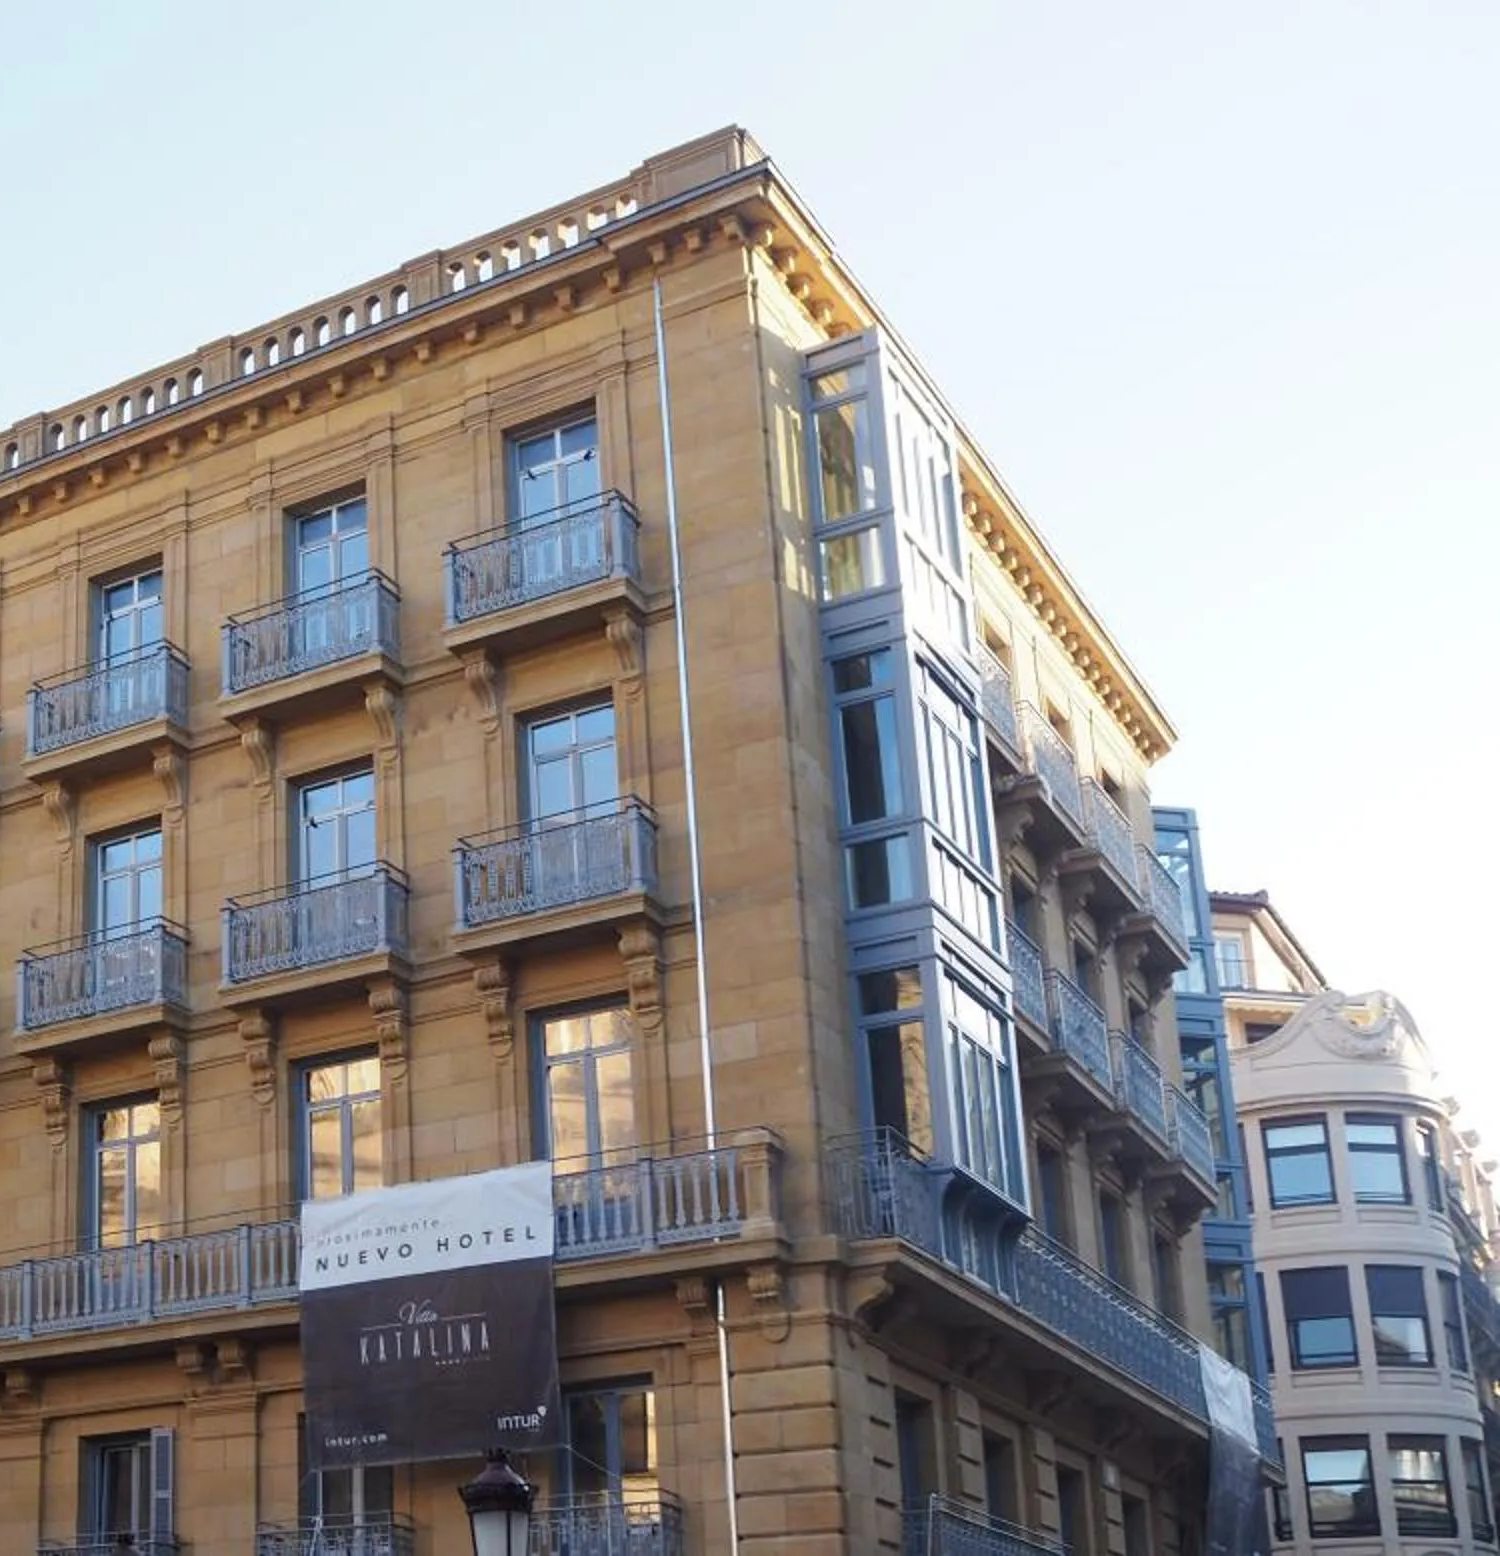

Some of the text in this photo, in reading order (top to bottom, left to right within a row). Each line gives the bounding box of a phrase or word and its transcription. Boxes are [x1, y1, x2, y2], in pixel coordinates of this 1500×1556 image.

[315, 1225, 536, 1272] NUEVO HOTEL
[360, 1321, 490, 1365] KATALINA
[497, 1413, 541, 1431] INTUR
[325, 1433, 388, 1448] intur.com
